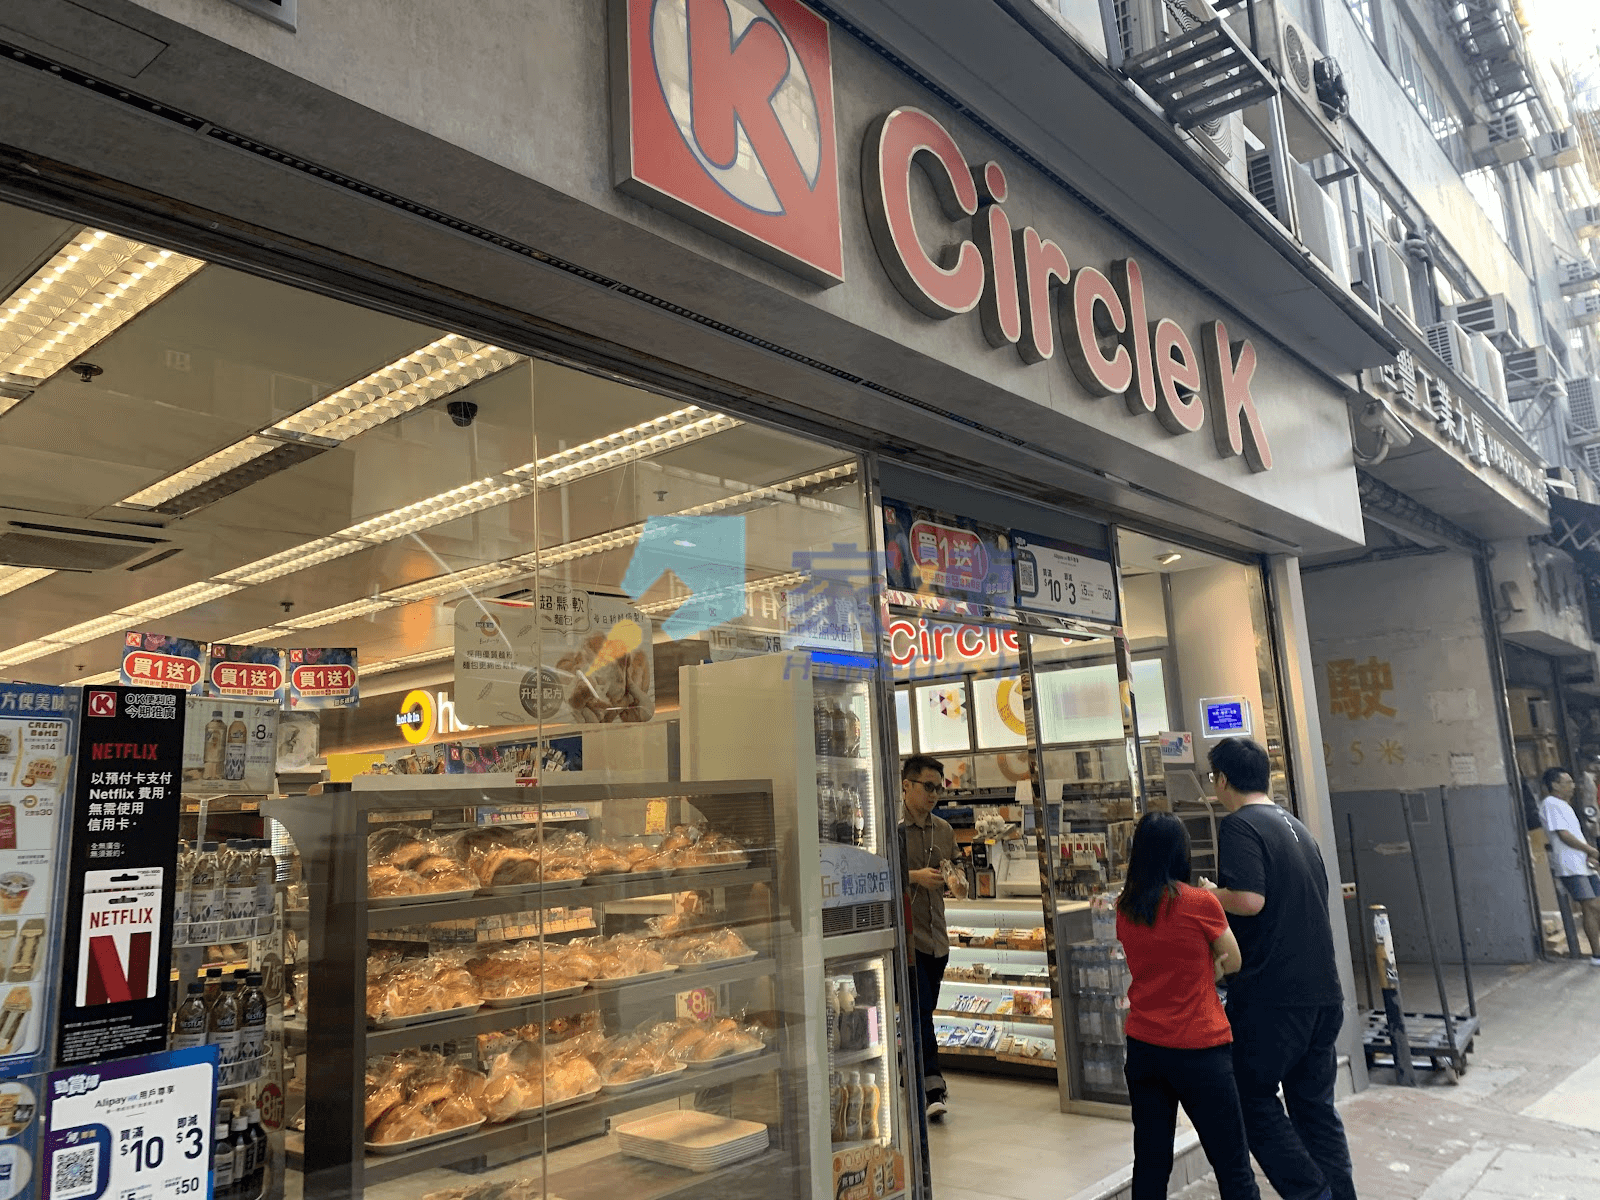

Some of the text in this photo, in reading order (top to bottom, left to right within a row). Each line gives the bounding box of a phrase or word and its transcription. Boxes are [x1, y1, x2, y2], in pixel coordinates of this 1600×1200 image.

[878, 106, 1272, 472] Circle K
[554, 613, 573, 626] 麵包
[889, 618, 1019, 667] Circle
[132, 657, 197, 683] 買1送1
[221, 668, 277, 688] 買1送1
[300, 670, 352, 688] 買1送1
[1327, 656, 1398, 721] 駛
[125, 693, 177, 706] OK便利店
[125, 705, 177, 719] 今期推廣
[92, 743, 159, 760] NETFLIX
[90, 772, 173, 785] 以預付卡支付
[89, 788, 135, 800] Netflix
[88, 802, 144, 816] 無需使用
[89, 907, 153, 929] NETFLIX
[139, 1085, 175, 1100] 用戶尊享
[177, 1114, 198, 1129] 即減
[120, 1126, 144, 1142] 買滿
[176, 1127, 203, 1159] $3
[120, 1136, 164, 1172] $10
[176, 1177, 199, 1195] $50
